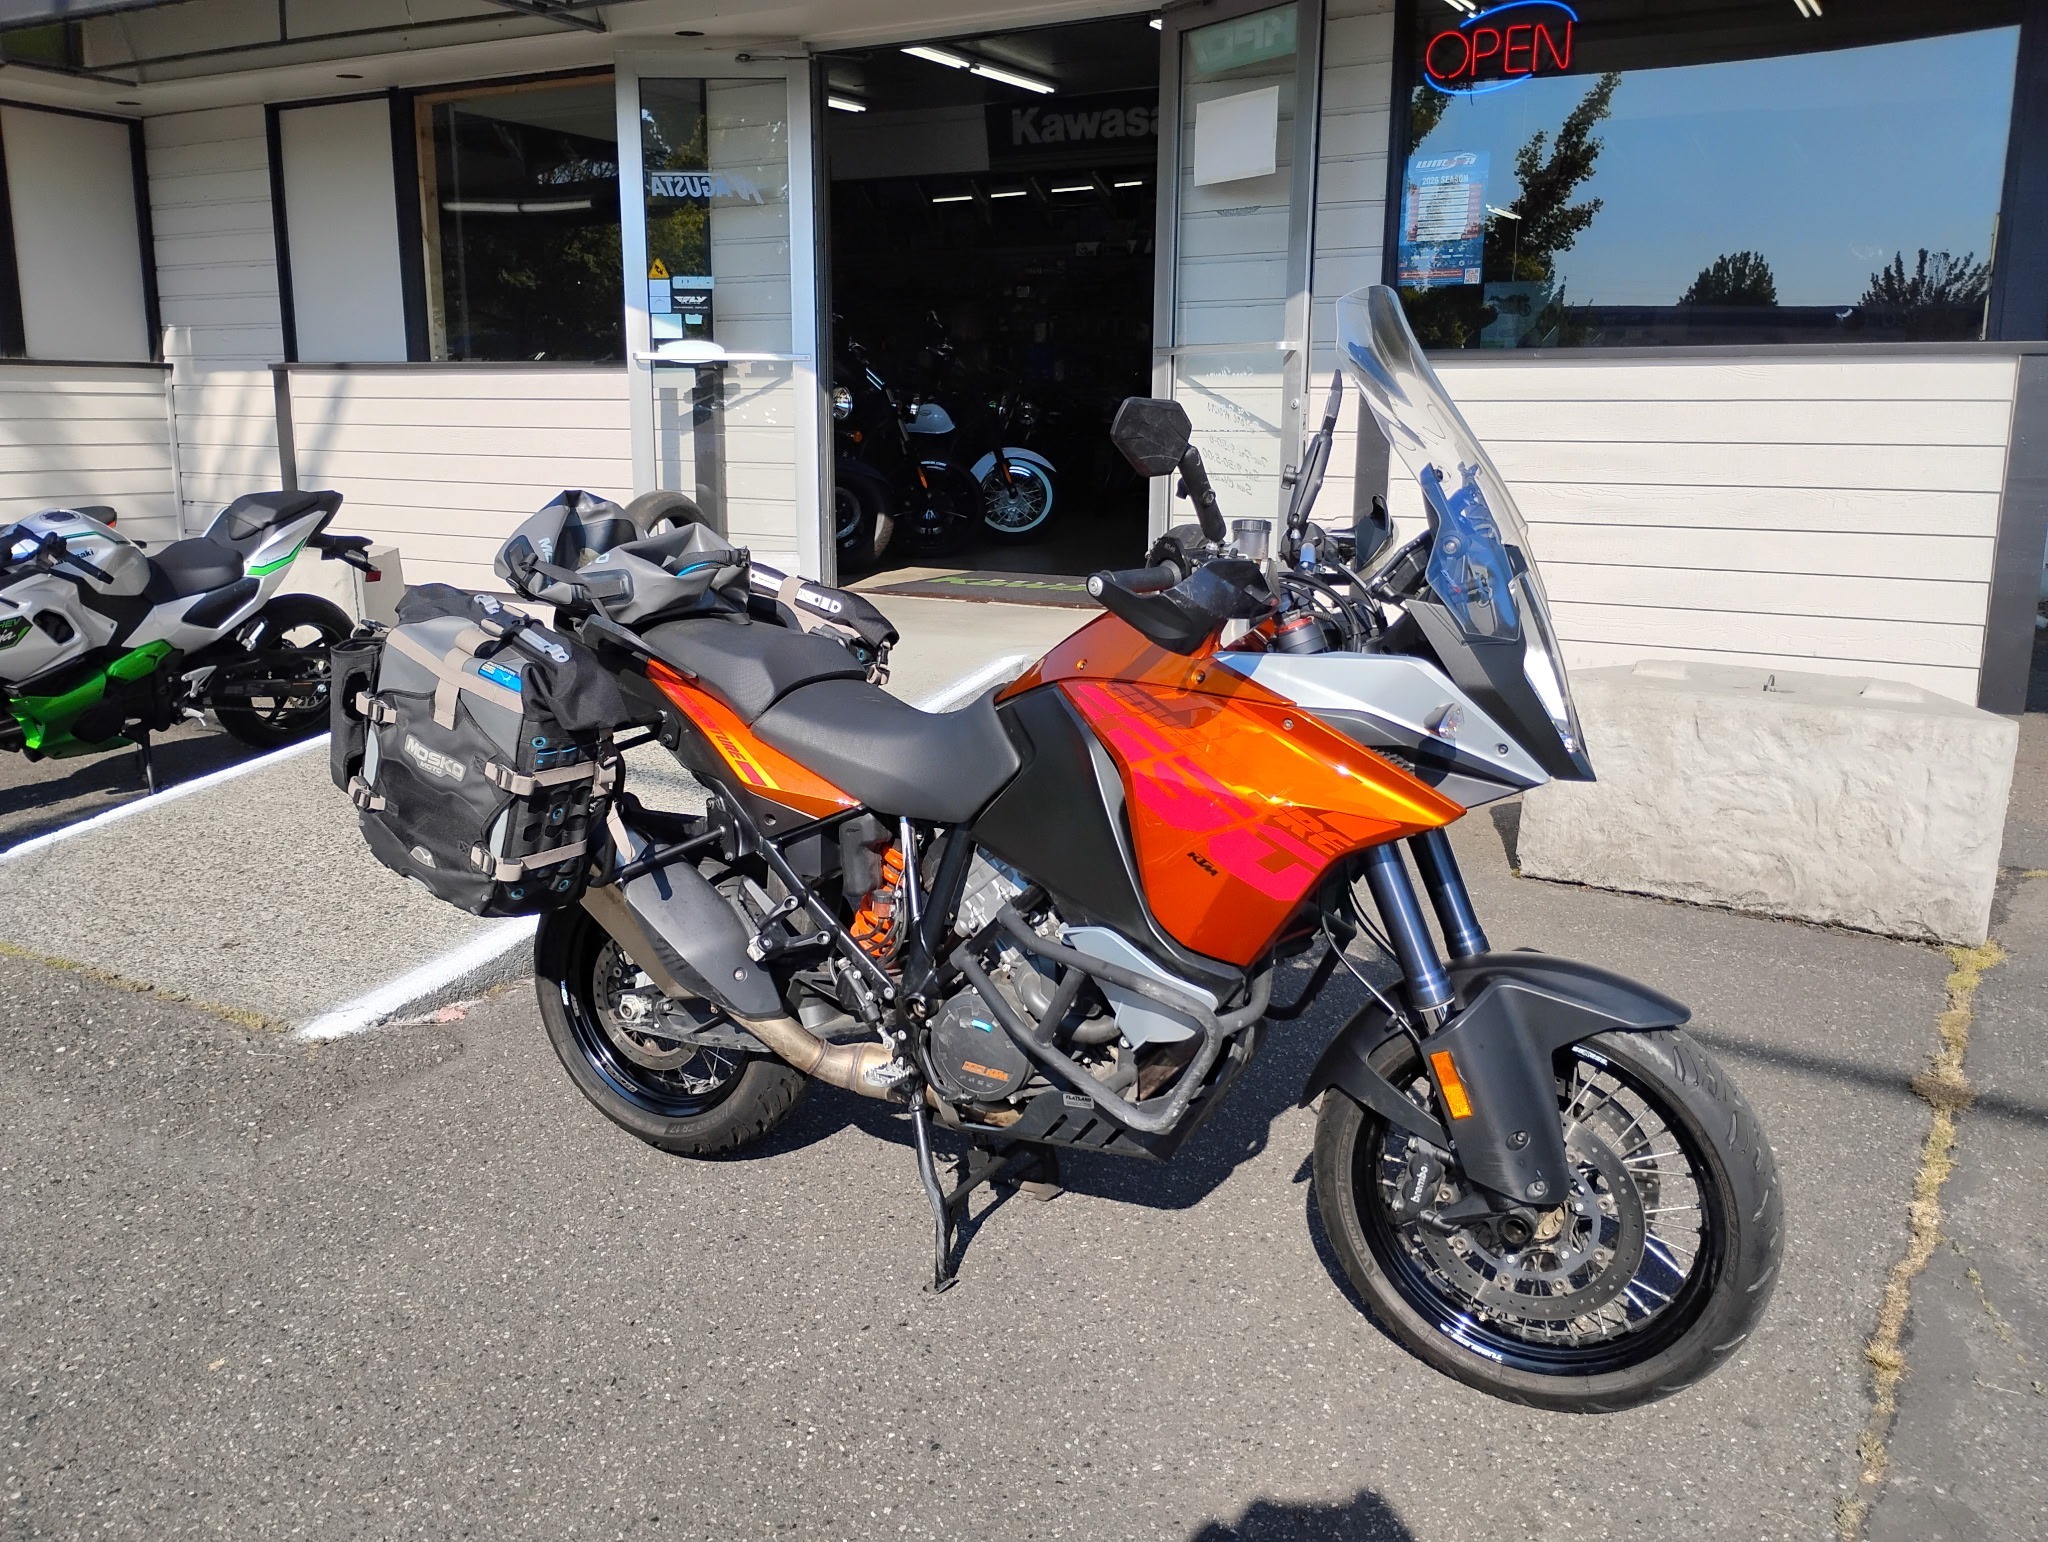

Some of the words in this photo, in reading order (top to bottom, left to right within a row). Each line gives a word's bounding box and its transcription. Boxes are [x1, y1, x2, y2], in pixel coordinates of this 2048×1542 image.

[1426, 20, 1572, 79] OPEN
[1012, 106, 1159, 145] Kawas
[1440, 175, 1469, 184] SEASON
[406, 738, 465, 778] MOSKO
[420, 761, 442, 774] MOTO
[1187, 851, 1219, 877] KTM
[1410, 1166, 1429, 1203] brembo
